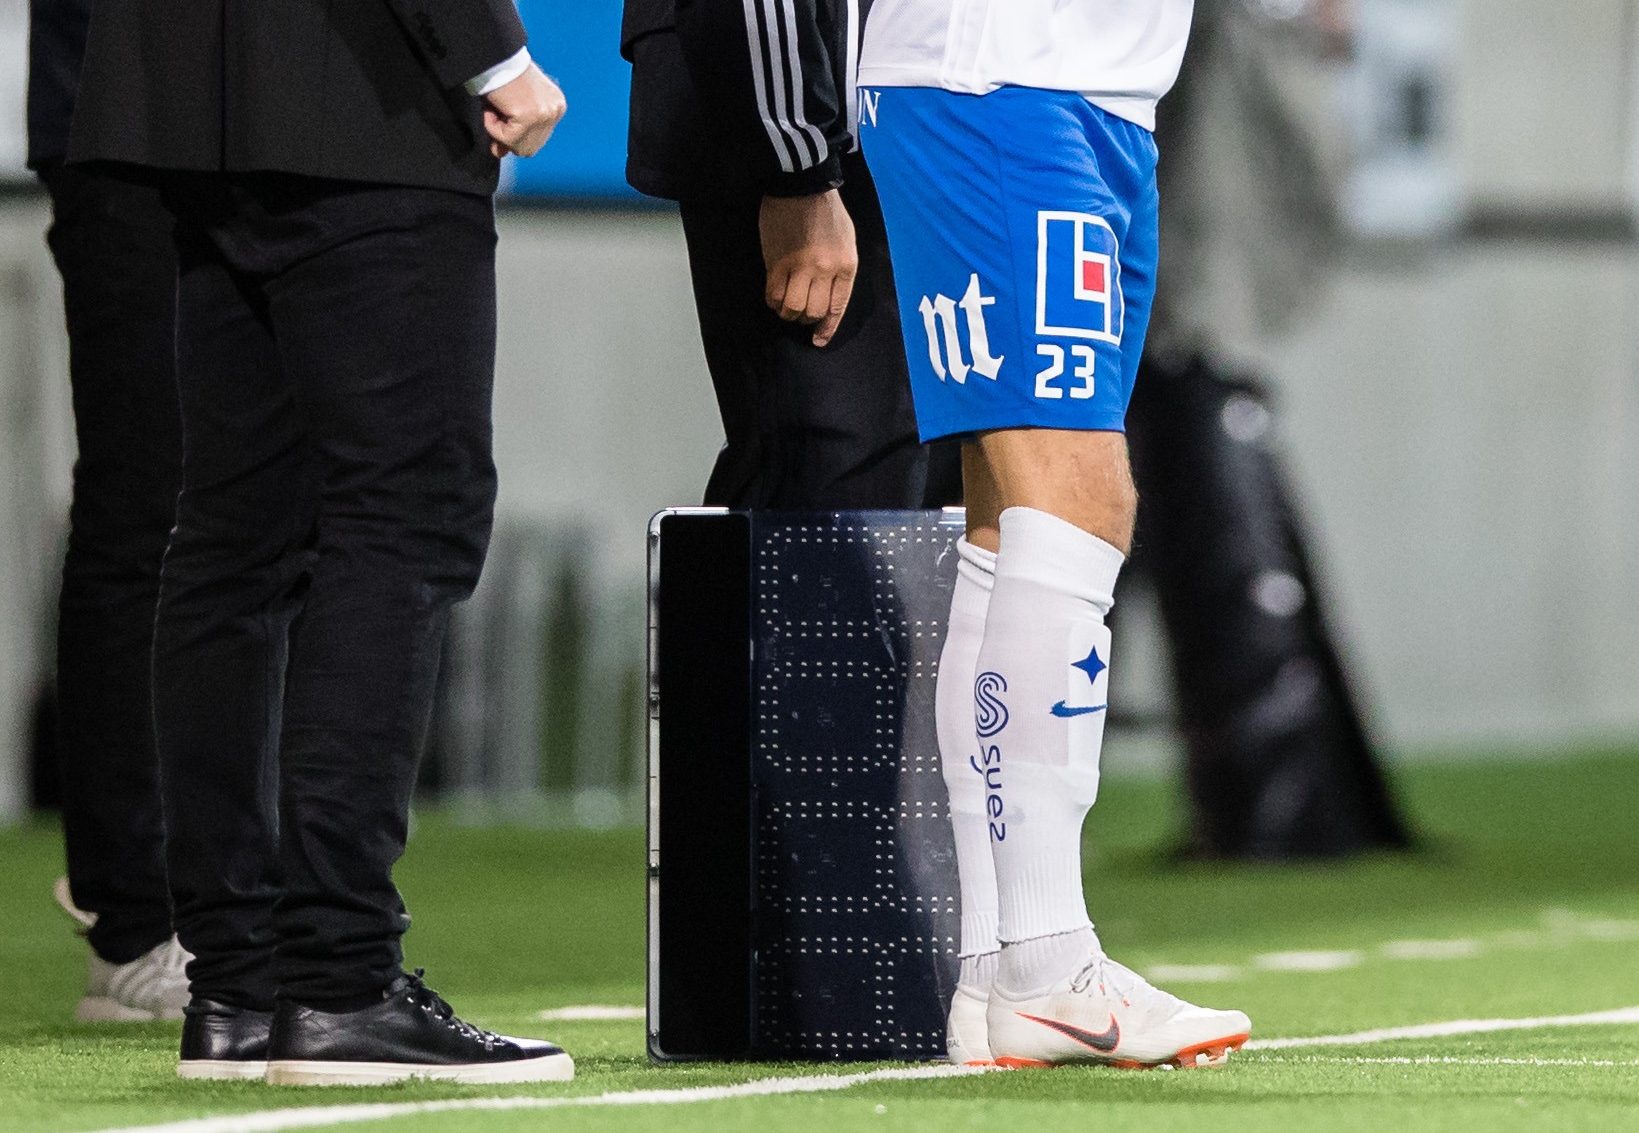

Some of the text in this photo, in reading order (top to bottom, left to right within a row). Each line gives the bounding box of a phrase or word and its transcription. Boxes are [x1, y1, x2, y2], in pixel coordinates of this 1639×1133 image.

[918, 273, 1005, 385] nt
[1034, 343, 1095, 399] 23
[981, 745, 1006, 843] suez
